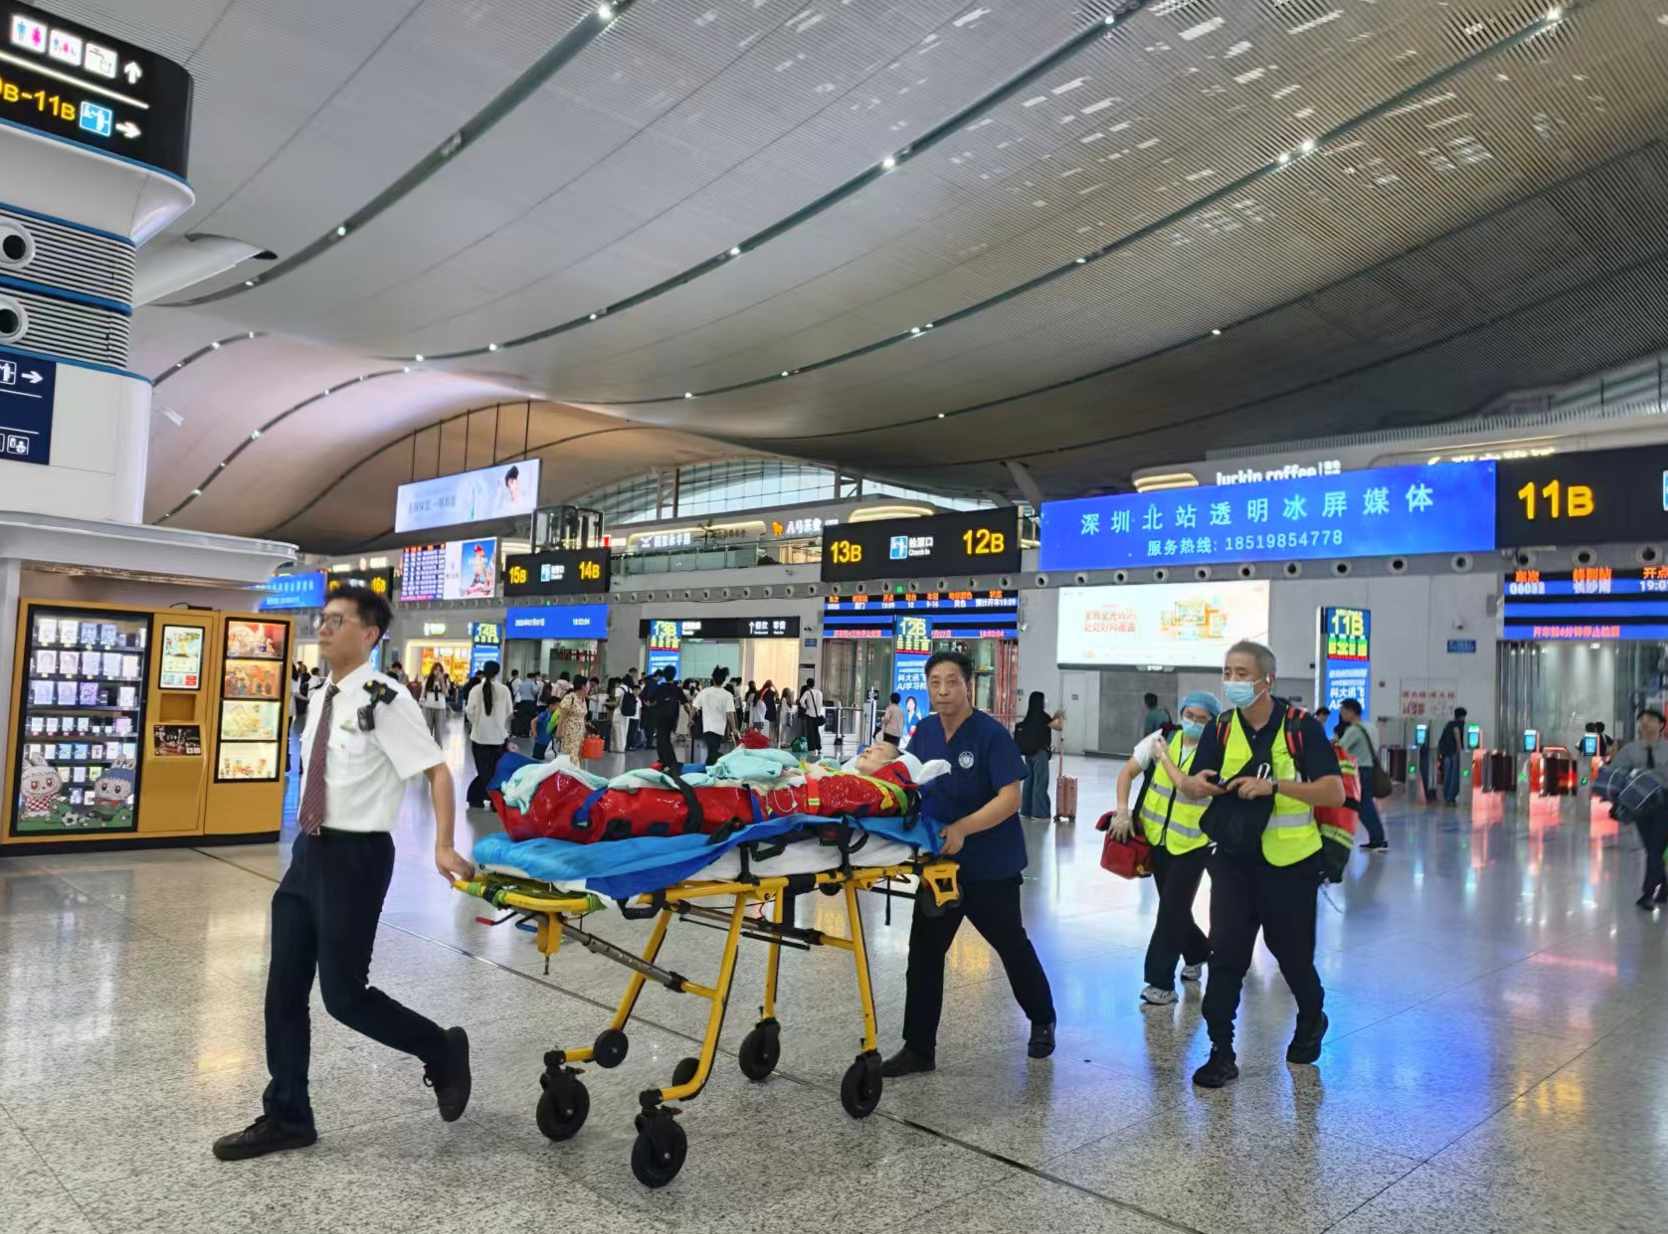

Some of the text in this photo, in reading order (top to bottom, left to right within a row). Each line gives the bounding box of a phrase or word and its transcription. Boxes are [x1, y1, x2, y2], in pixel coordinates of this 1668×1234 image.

[0, 79, 76, 121] B-11B
[1080, 483, 1434, 536] 深圳北站透明冰屏媒体
[1517, 479, 1595, 520] 11B
[830, 540, 863, 564] 13B
[962, 529, 1005, 555] 12B
[1224, 529, 1344, 552] 18519854778
[509, 566, 528, 584] 15B
[579, 560, 601, 580] 14B
[1640, 580, 1668, 592] 19:0
